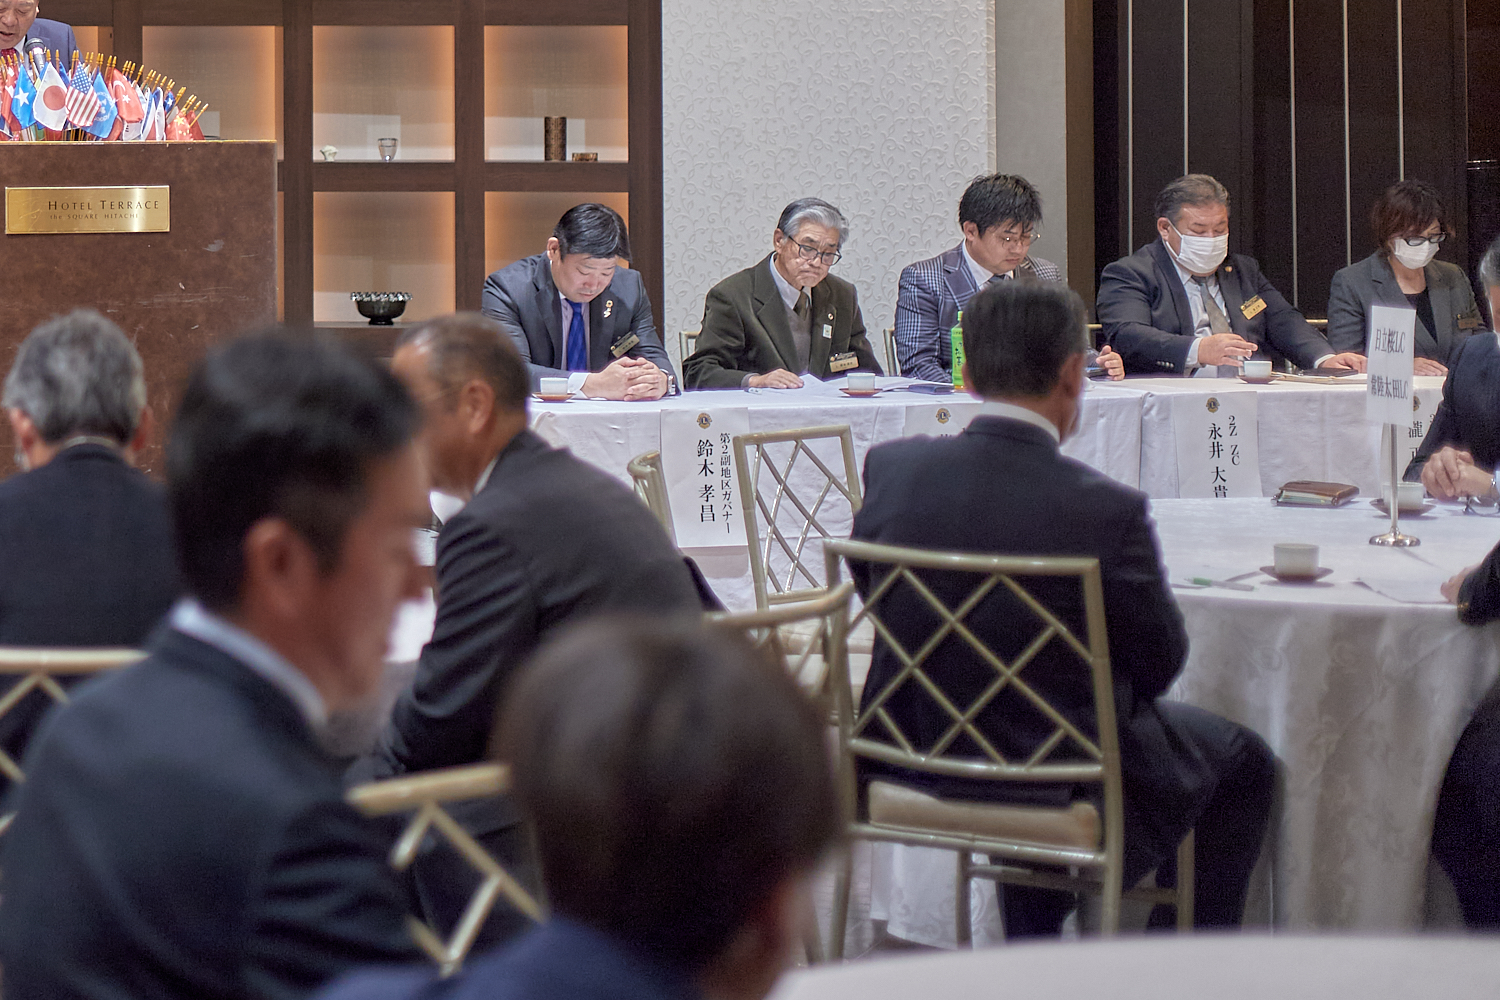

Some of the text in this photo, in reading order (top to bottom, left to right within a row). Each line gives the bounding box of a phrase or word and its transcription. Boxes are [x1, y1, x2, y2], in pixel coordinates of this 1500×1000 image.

[719, 432, 733, 534] 第2副地区ガバナー
